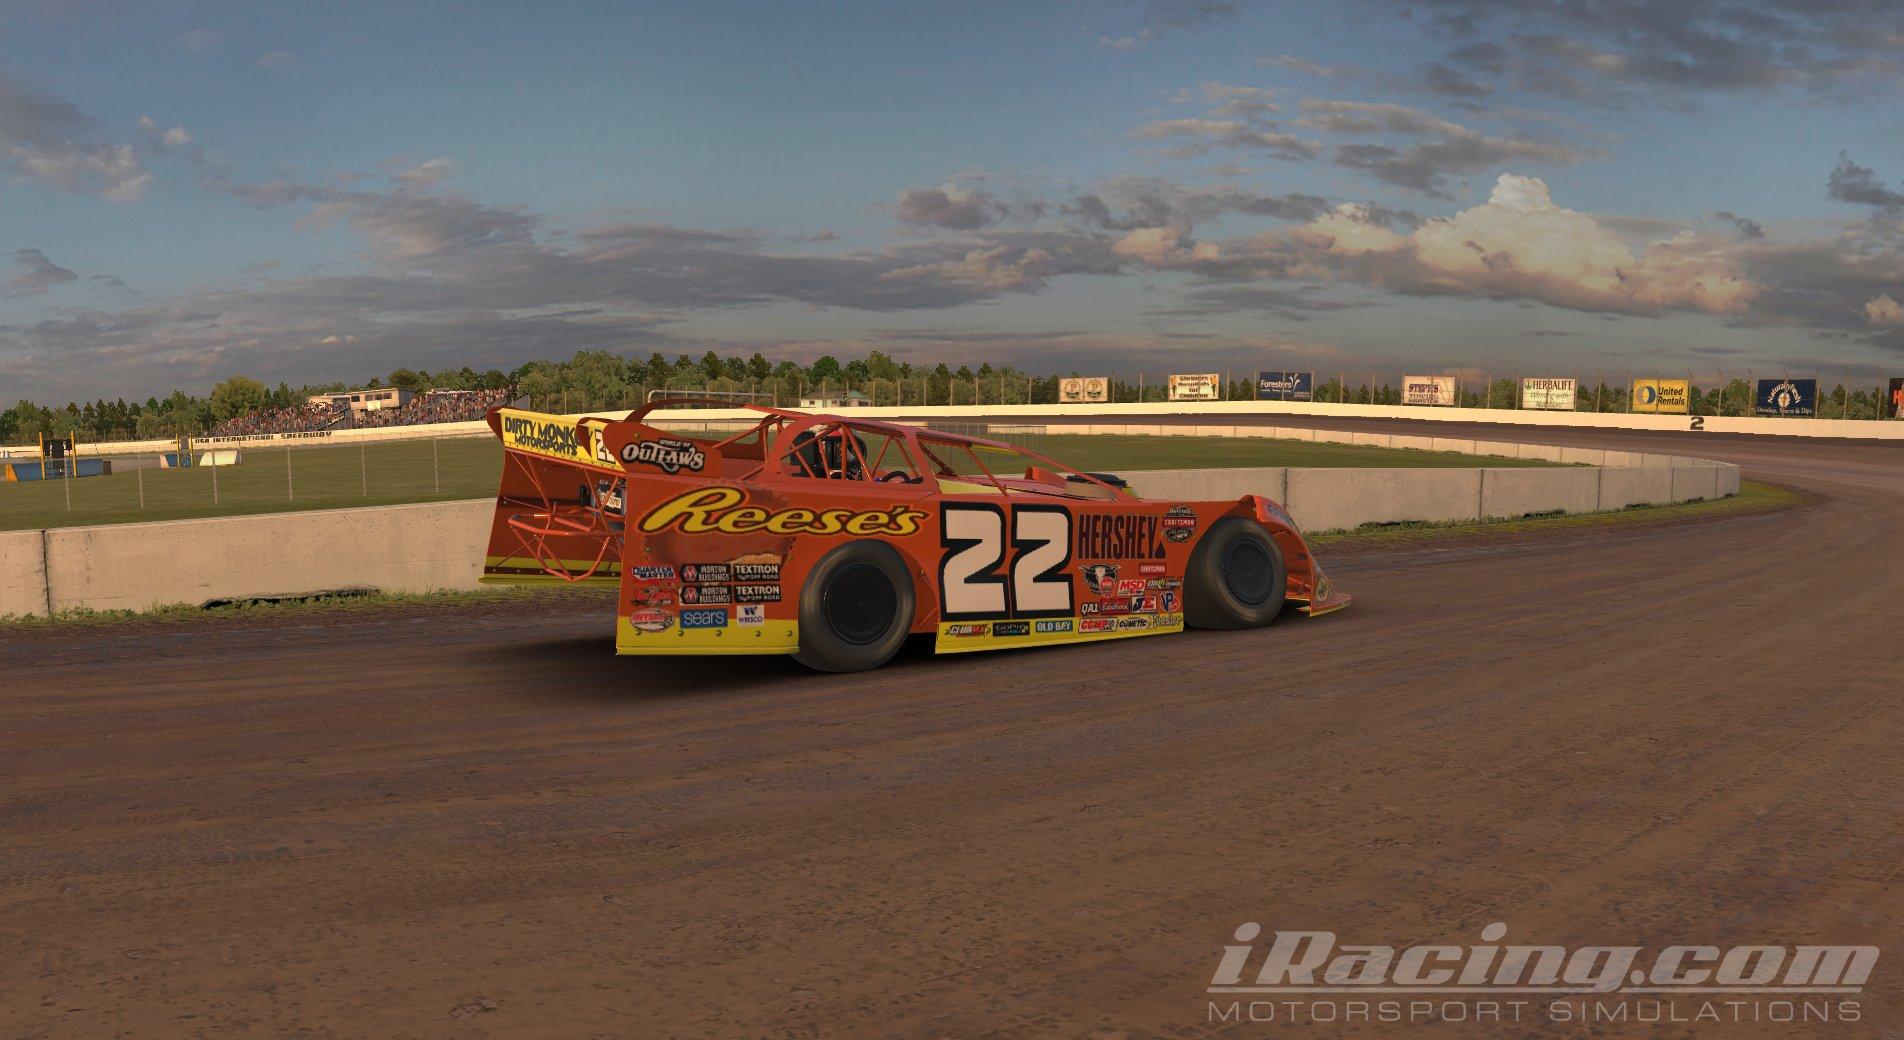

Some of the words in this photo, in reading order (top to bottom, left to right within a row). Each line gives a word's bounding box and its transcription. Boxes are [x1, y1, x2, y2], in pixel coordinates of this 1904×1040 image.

[1260, 379, 1292, 389] Foresters
[1532, 380, 1572, 390] HERBALIFE
[1658, 387, 1684, 396] United
[1657, 396, 1685, 406] Rentals
[504, 416, 537, 436] DIRTY
[1690, 416, 1705, 431] 2
[213, 434, 274, 443] INTERNATIONAL
[280, 431, 332, 440] SPEEDWAY
[515, 434, 578, 456] MOTORSPORTS
[640, 487, 928, 534] Reese's
[1077, 514, 1160, 560] HERSHEY
[940, 503, 1074, 618] 22
[734, 565, 778, 574] TEXTRON
[736, 586, 780, 595] TEXTRON
[1119, 580, 1146, 590] MSD
[1081, 603, 1099, 615] QA1
[684, 611, 724, 626] sears
[1036, 622, 1053, 632] OLD
[1055, 621, 1071, 631] BAY
